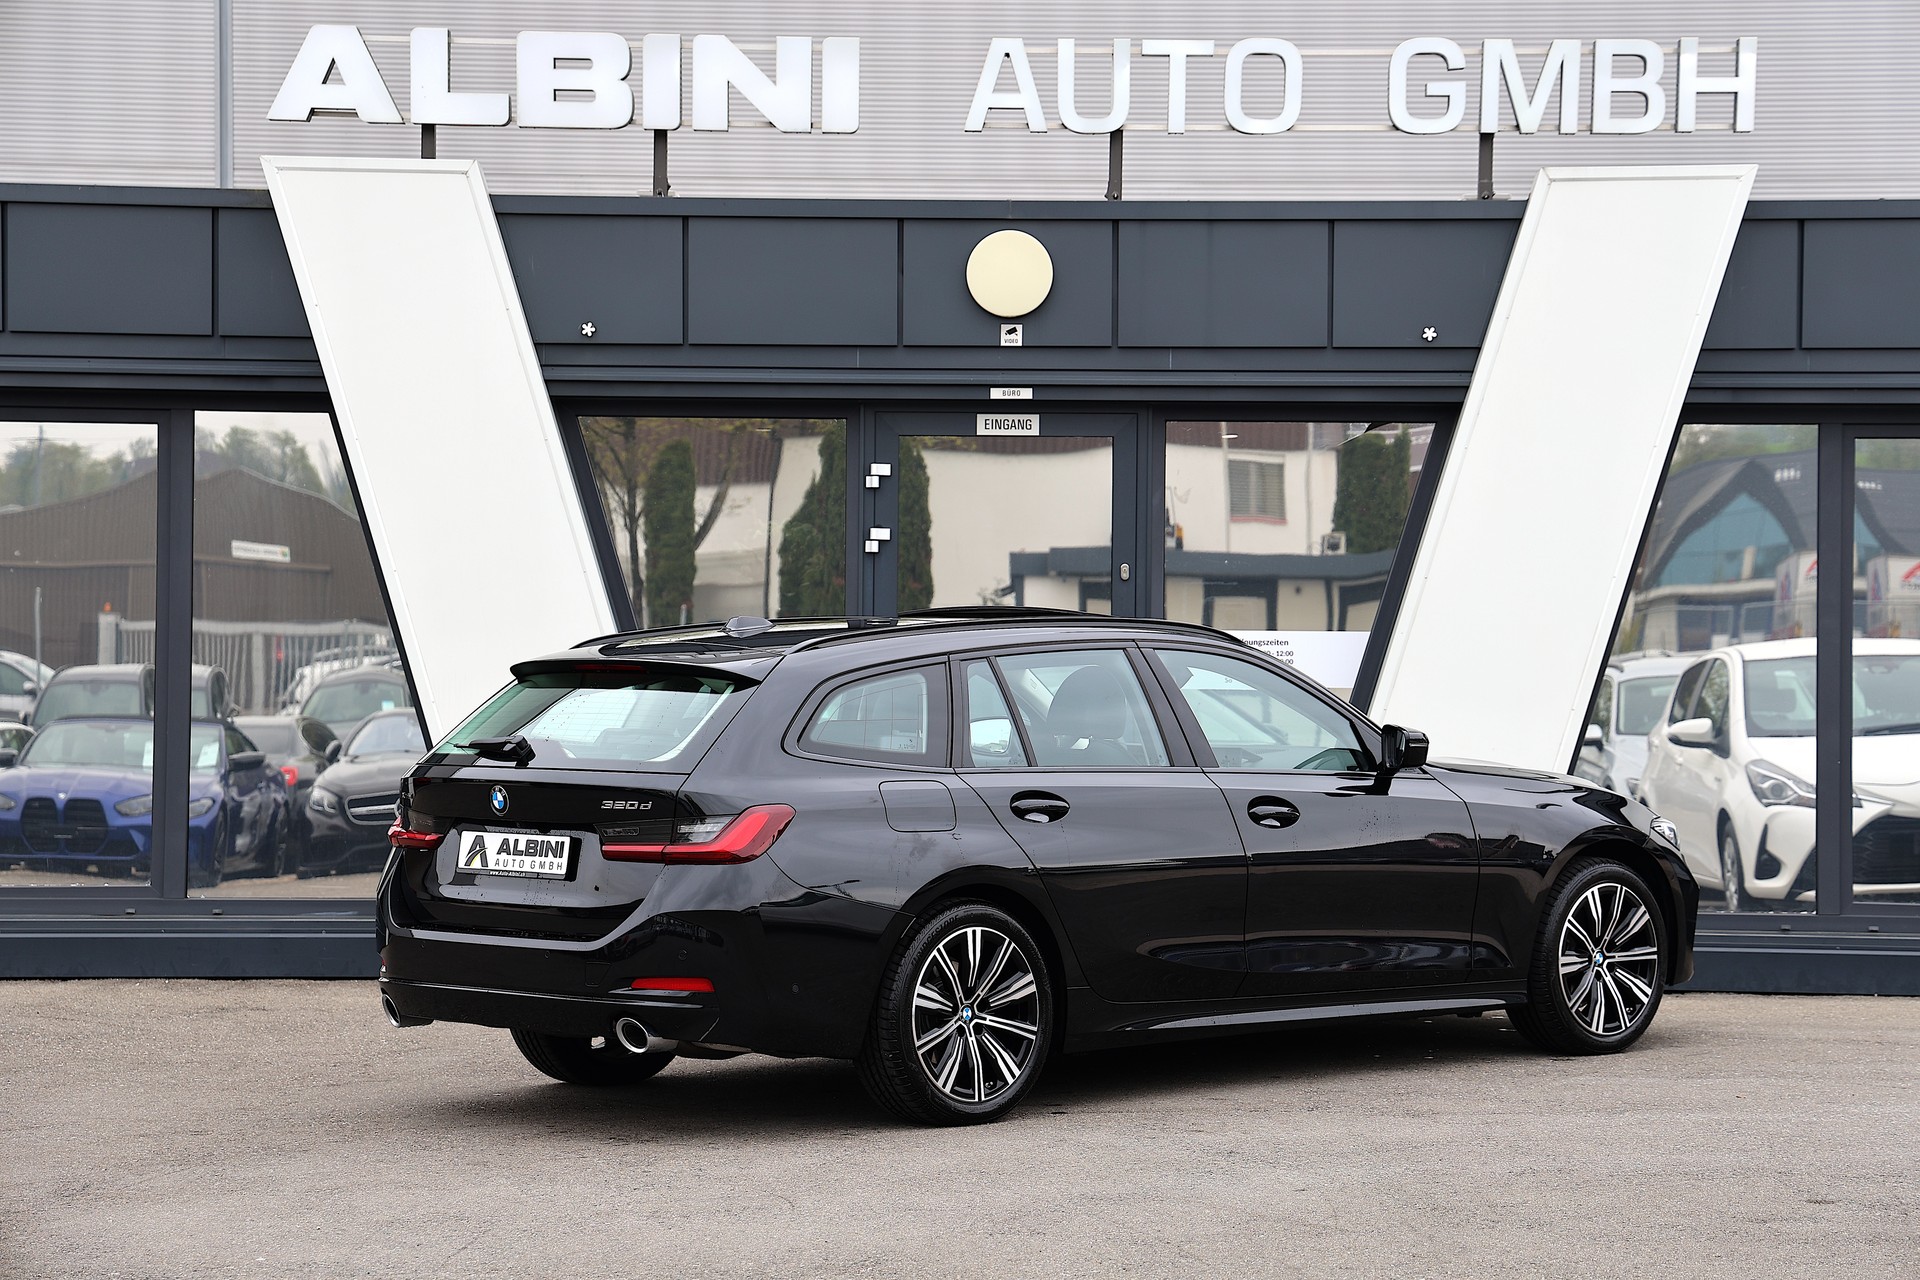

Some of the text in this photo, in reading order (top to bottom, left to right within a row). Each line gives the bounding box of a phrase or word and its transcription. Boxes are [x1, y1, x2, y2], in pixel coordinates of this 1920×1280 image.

[266, 24, 1759, 135] ALBINI AUTO GMBH
[1002, 389, 1021, 397] BÜRO
[984, 418, 1033, 431] EINGANG
[600, 800, 653, 810] 320d
[496, 838, 565, 859] ALBINI
[494, 858, 563, 871] AUTO GMBH
